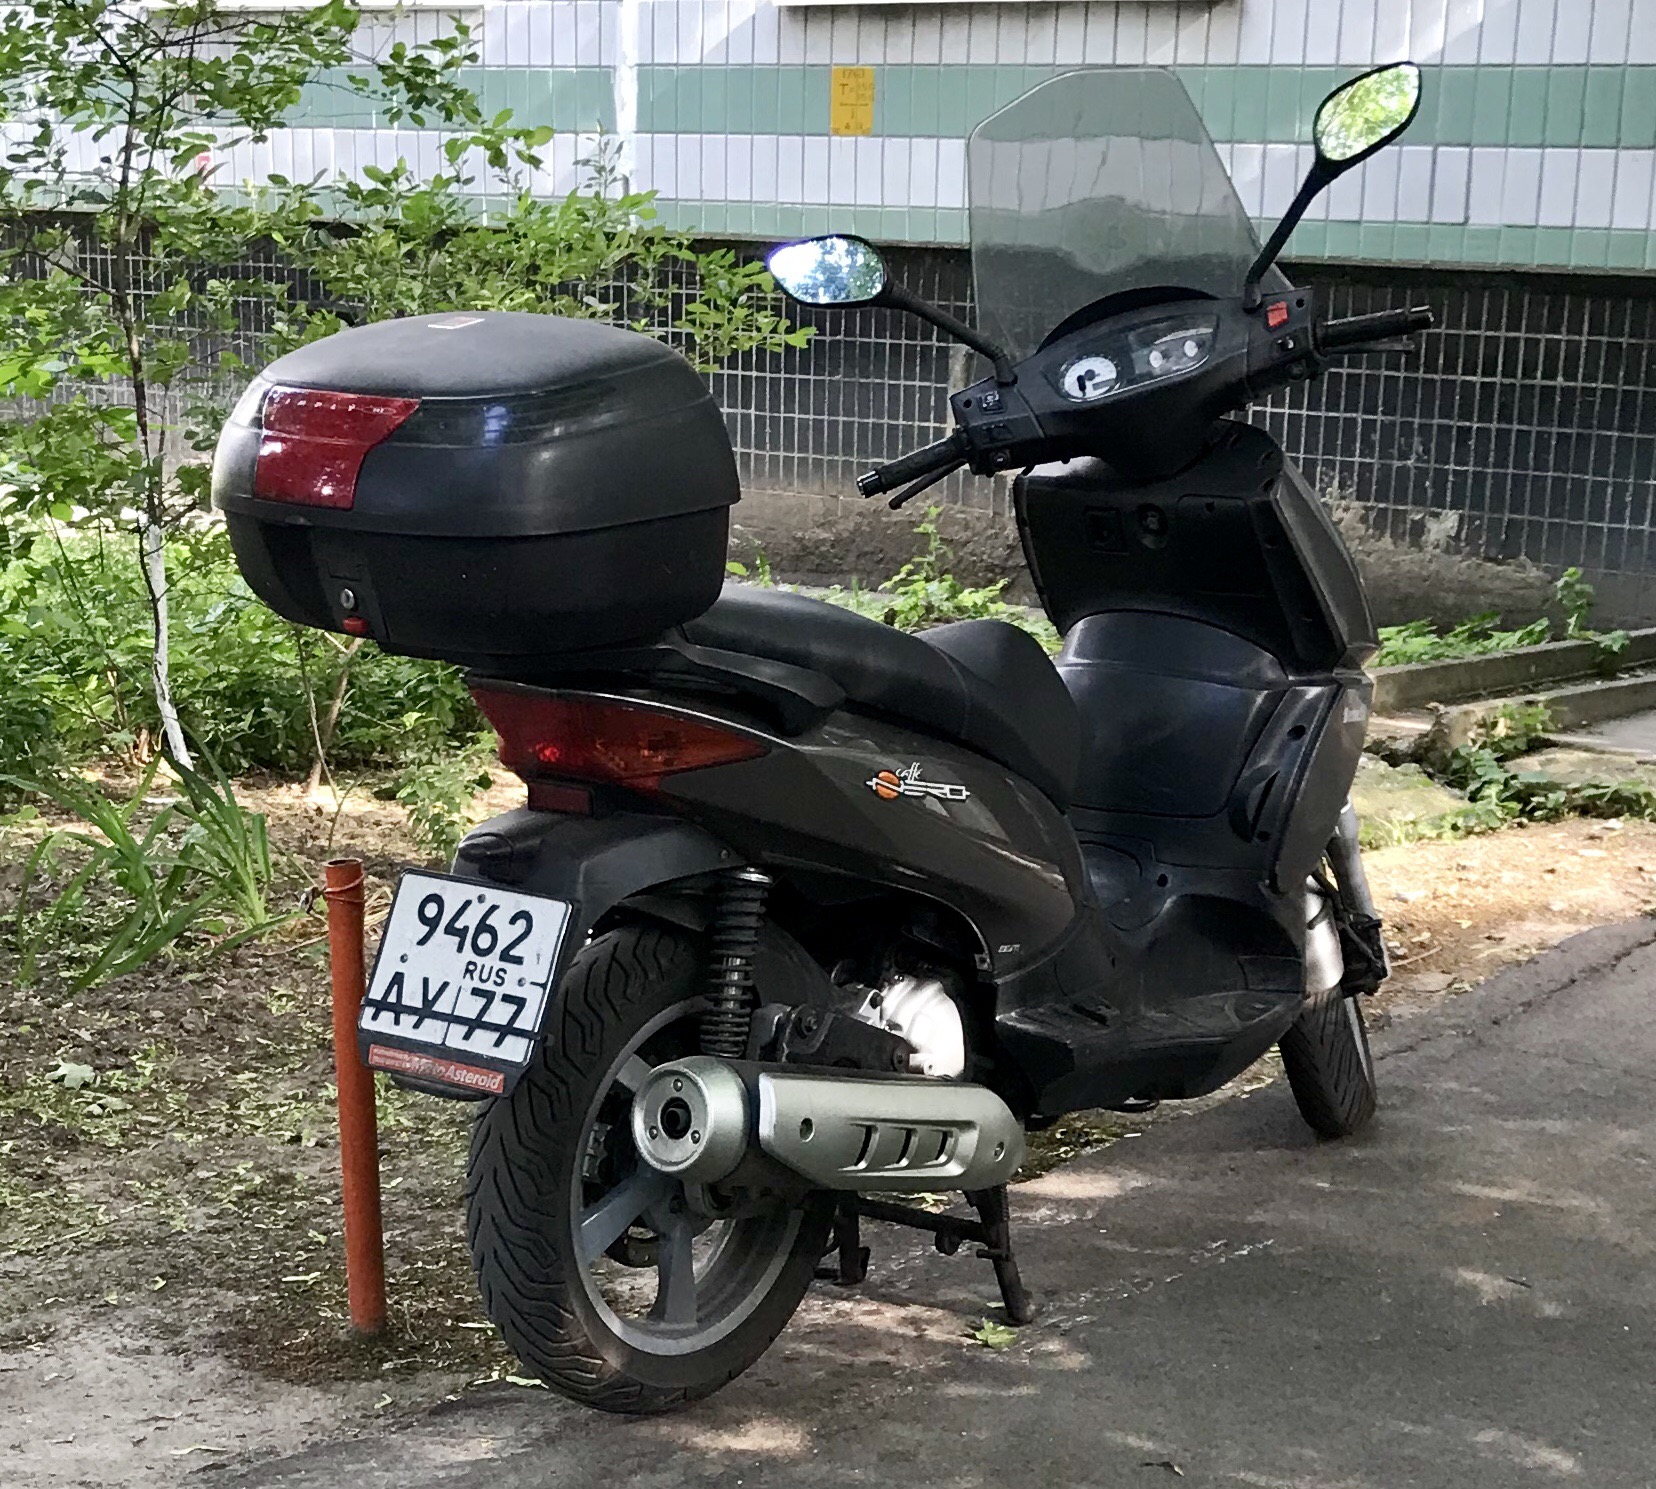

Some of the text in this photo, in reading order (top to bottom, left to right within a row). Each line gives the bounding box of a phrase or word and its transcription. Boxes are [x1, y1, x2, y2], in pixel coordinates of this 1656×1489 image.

[416, 893, 533, 965] 9462
[463, 961, 507, 986] RUS
[463, 987, 528, 1048] 77
[445, 1065, 501, 1090] Asteroid
